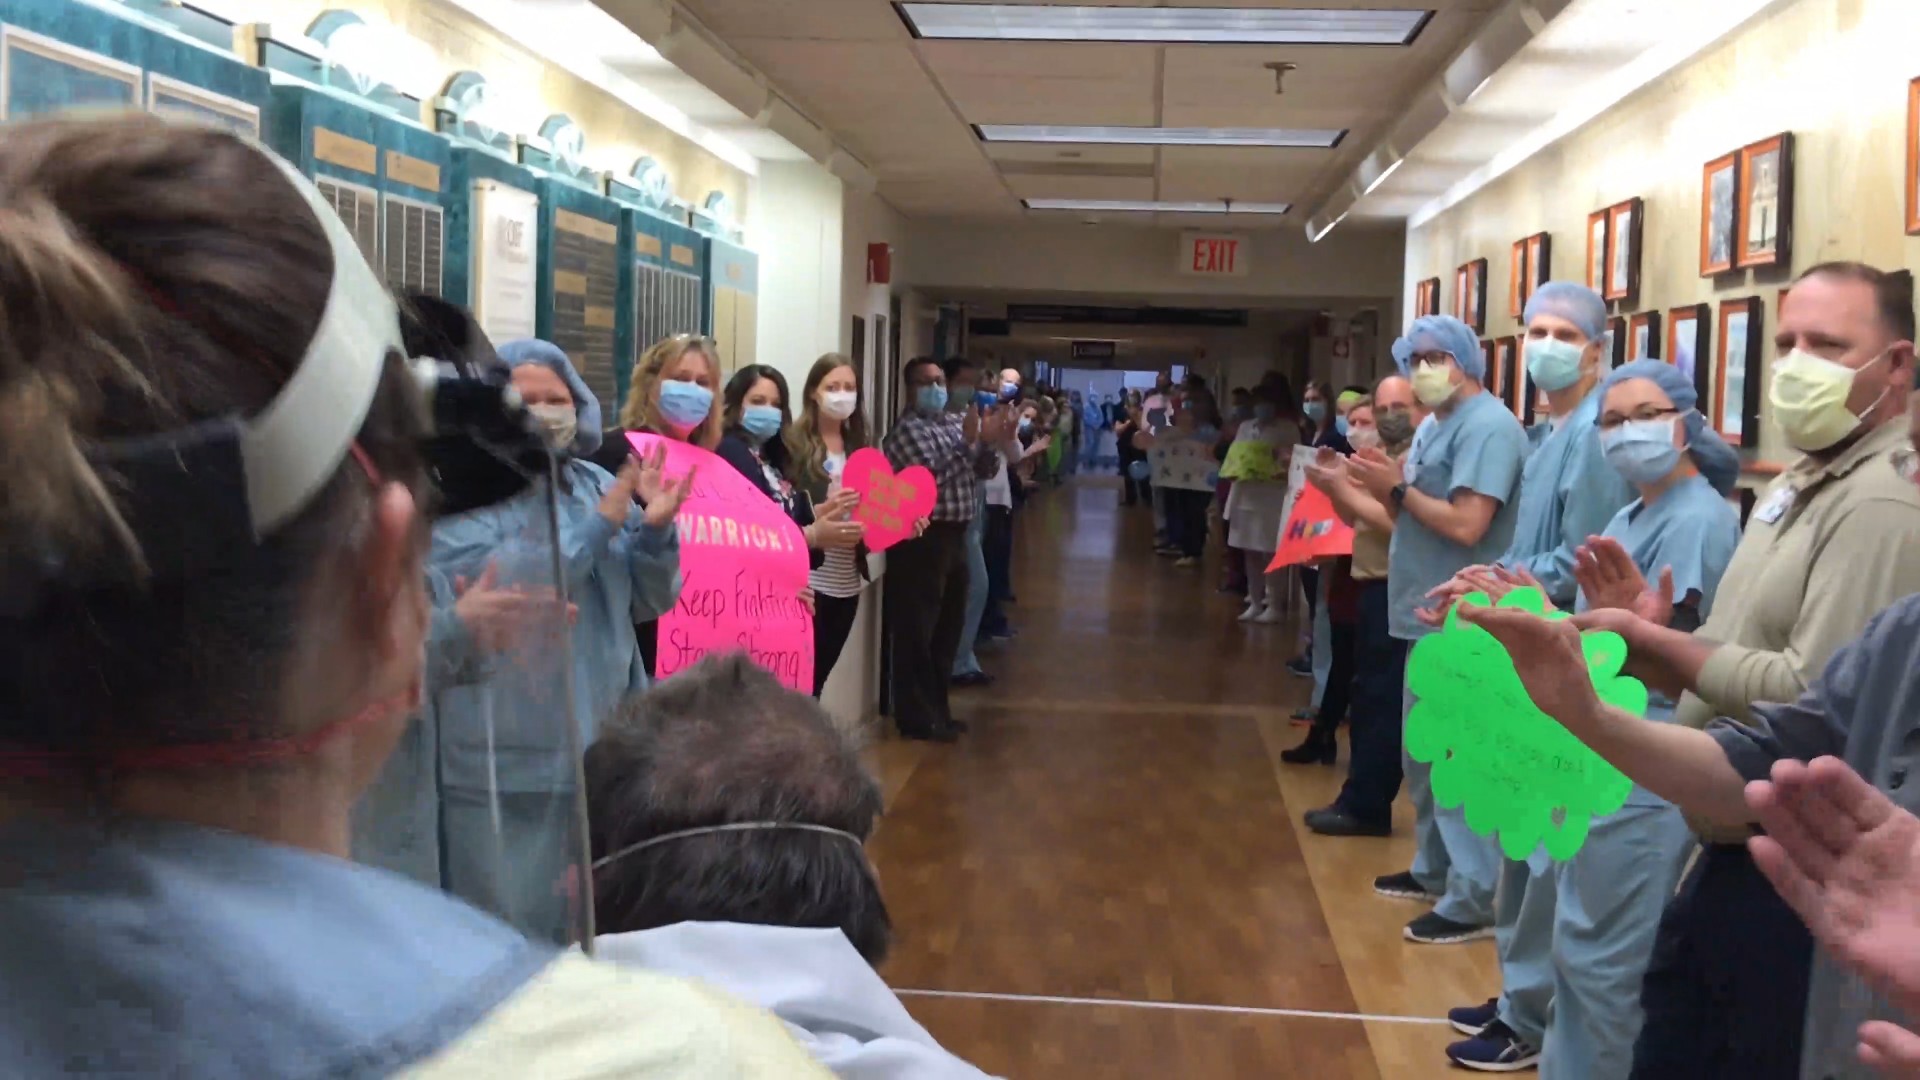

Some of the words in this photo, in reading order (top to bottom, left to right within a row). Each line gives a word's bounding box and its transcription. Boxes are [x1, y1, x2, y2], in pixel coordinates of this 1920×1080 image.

[1193, 239, 1238, 272] EXIT
[673, 569, 726, 628] Keep
[735, 568, 808, 632] Fighting
